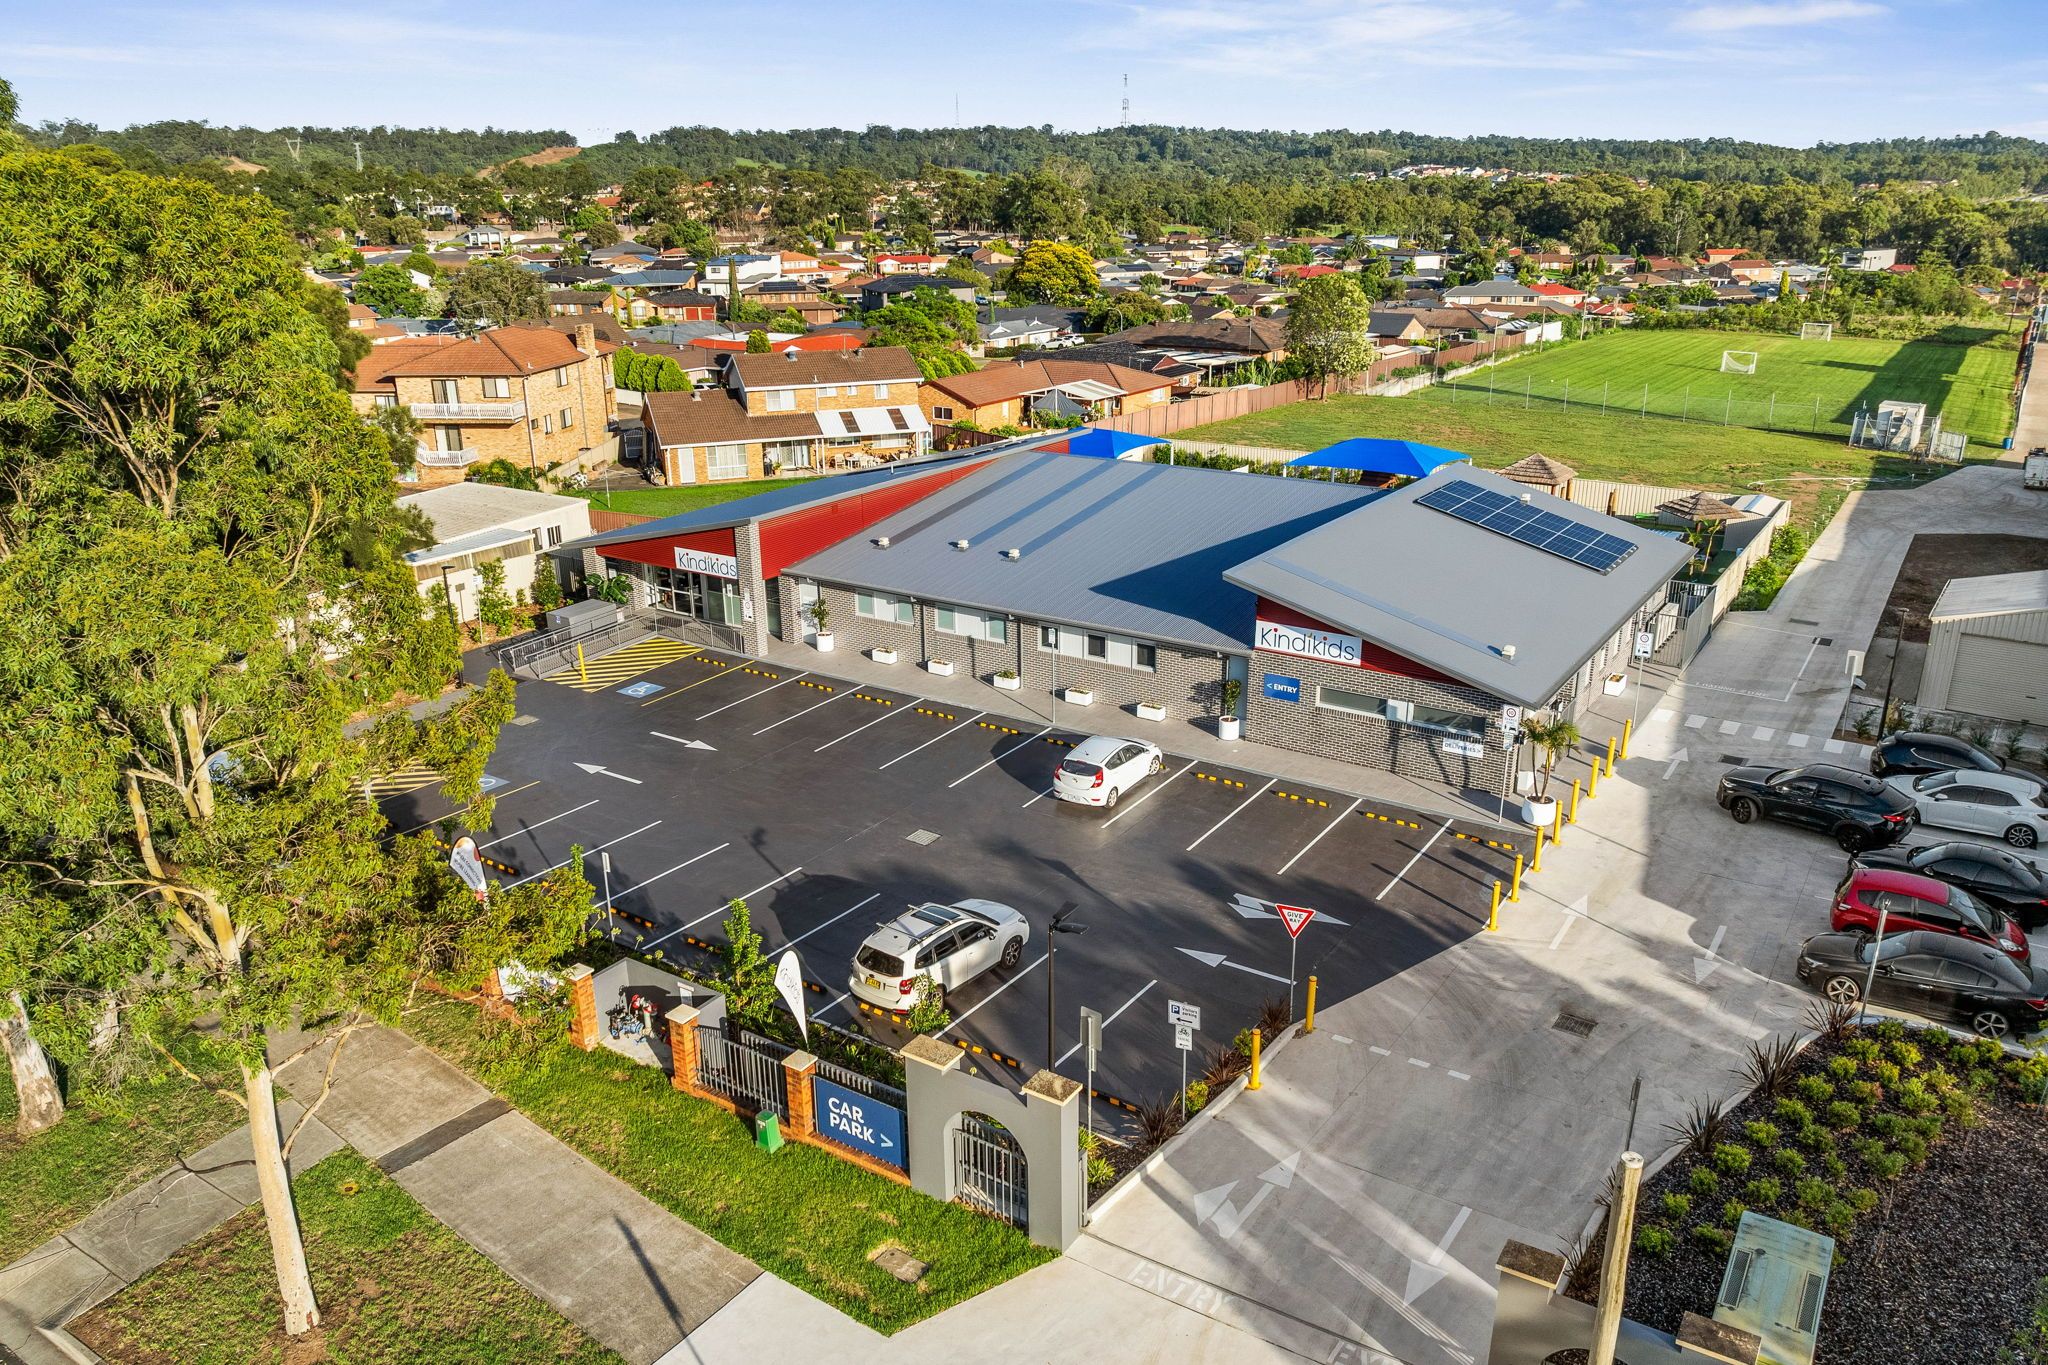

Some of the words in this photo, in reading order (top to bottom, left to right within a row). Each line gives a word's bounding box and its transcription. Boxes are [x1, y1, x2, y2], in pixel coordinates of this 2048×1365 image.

[678, 552, 737, 577] Kindikids
[1260, 627, 1355, 661] Kindikids
[1273, 683, 1298, 694] ENTRY
[1444, 742, 1476, 753] DELIVERIES
[1287, 911, 1304, 920] GIVE
[828, 1097, 864, 1124] CAR
[829, 1112, 876, 1144] PARK
[1127, 1260, 1233, 1316] ENTRY
